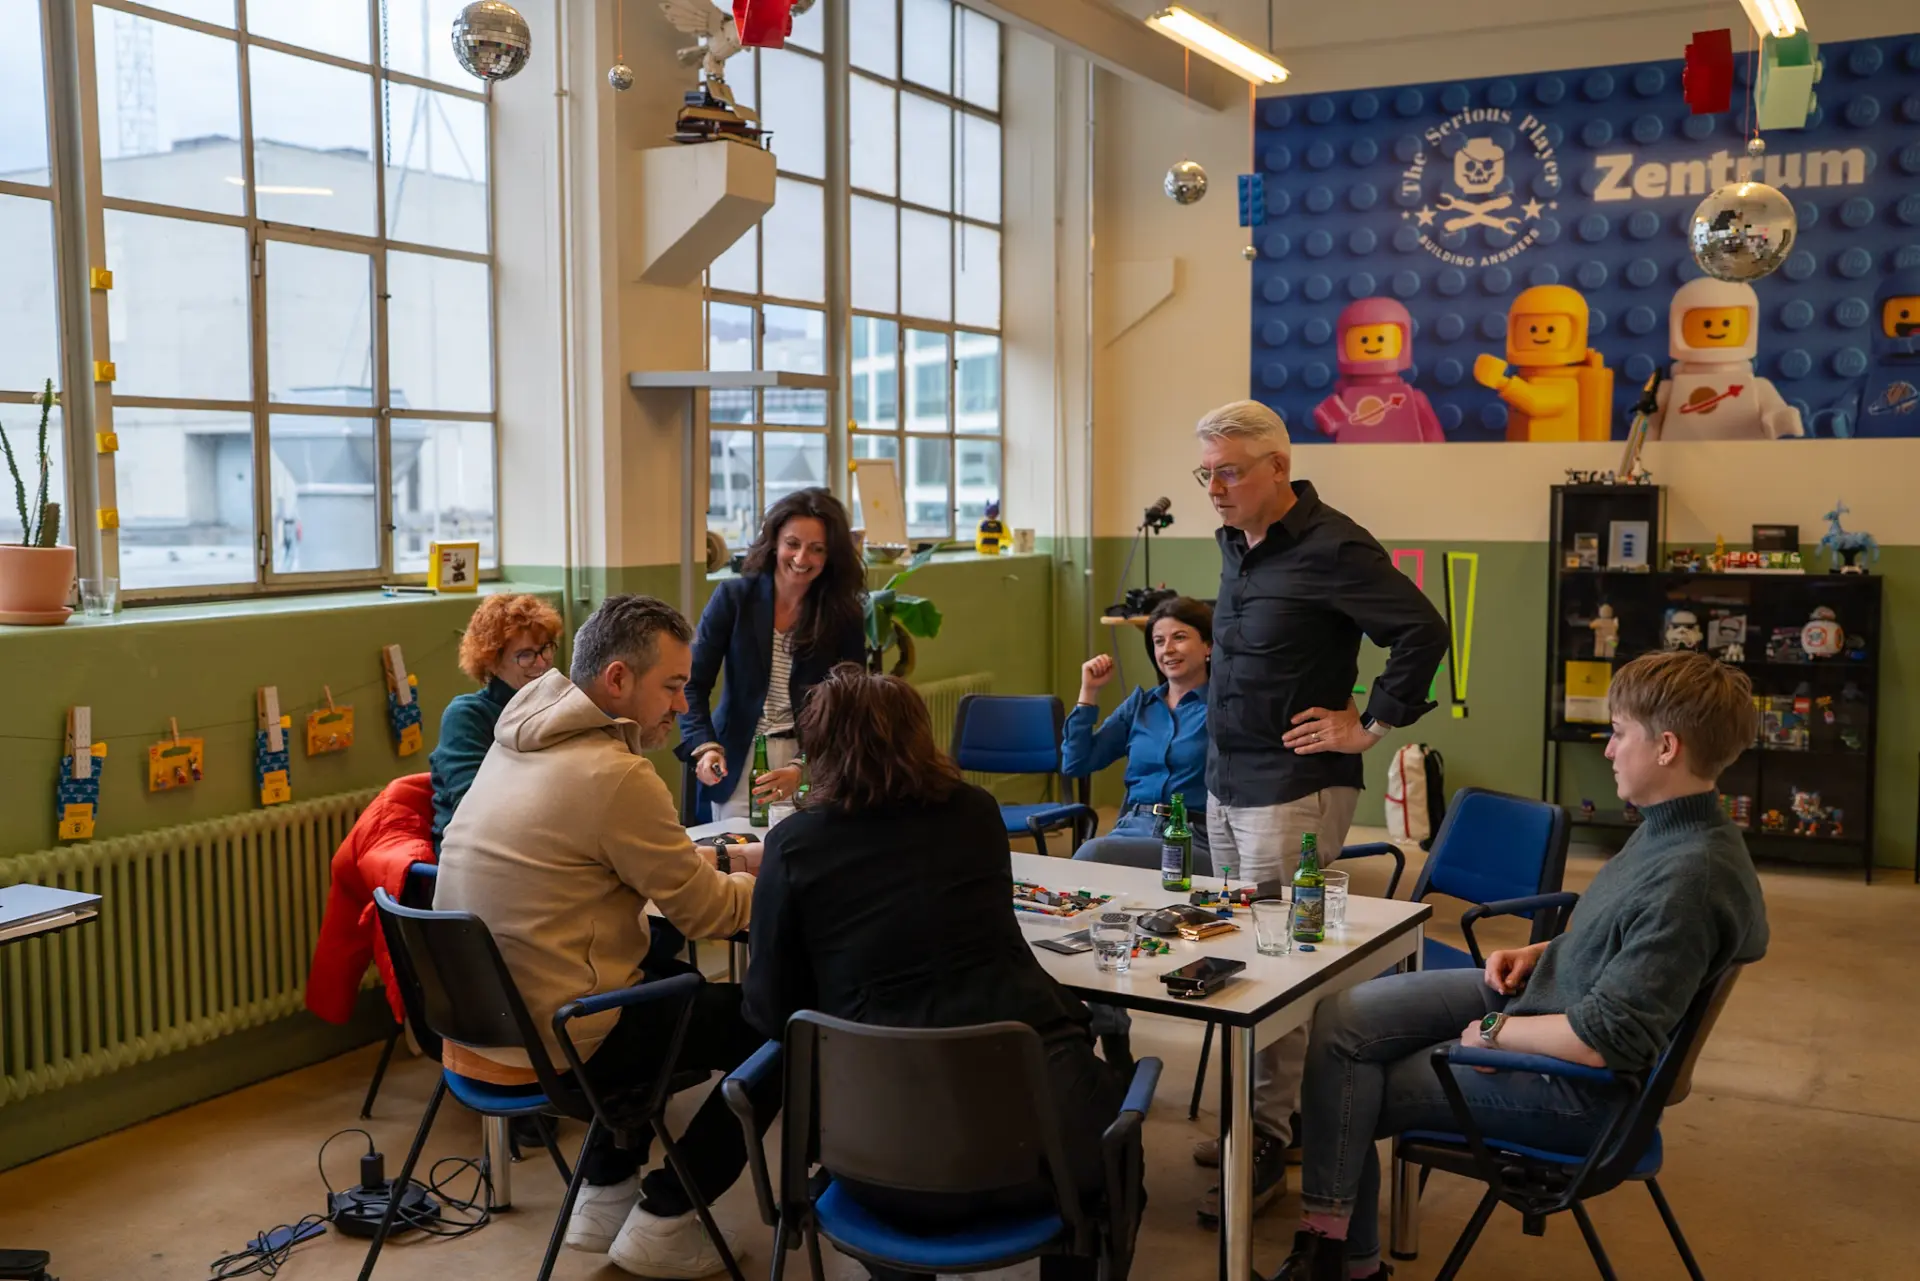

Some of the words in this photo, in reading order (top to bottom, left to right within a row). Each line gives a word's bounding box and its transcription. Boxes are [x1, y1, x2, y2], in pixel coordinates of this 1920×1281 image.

[1402, 152, 1427, 196] The
[1425, 106, 1512, 146] Serious
[1518, 114, 1558, 187] Player
[1594, 149, 1866, 201] Zentrum
[1418, 234, 1475, 267] BUILDING
[1480, 228, 1540, 267] ANSWERS
